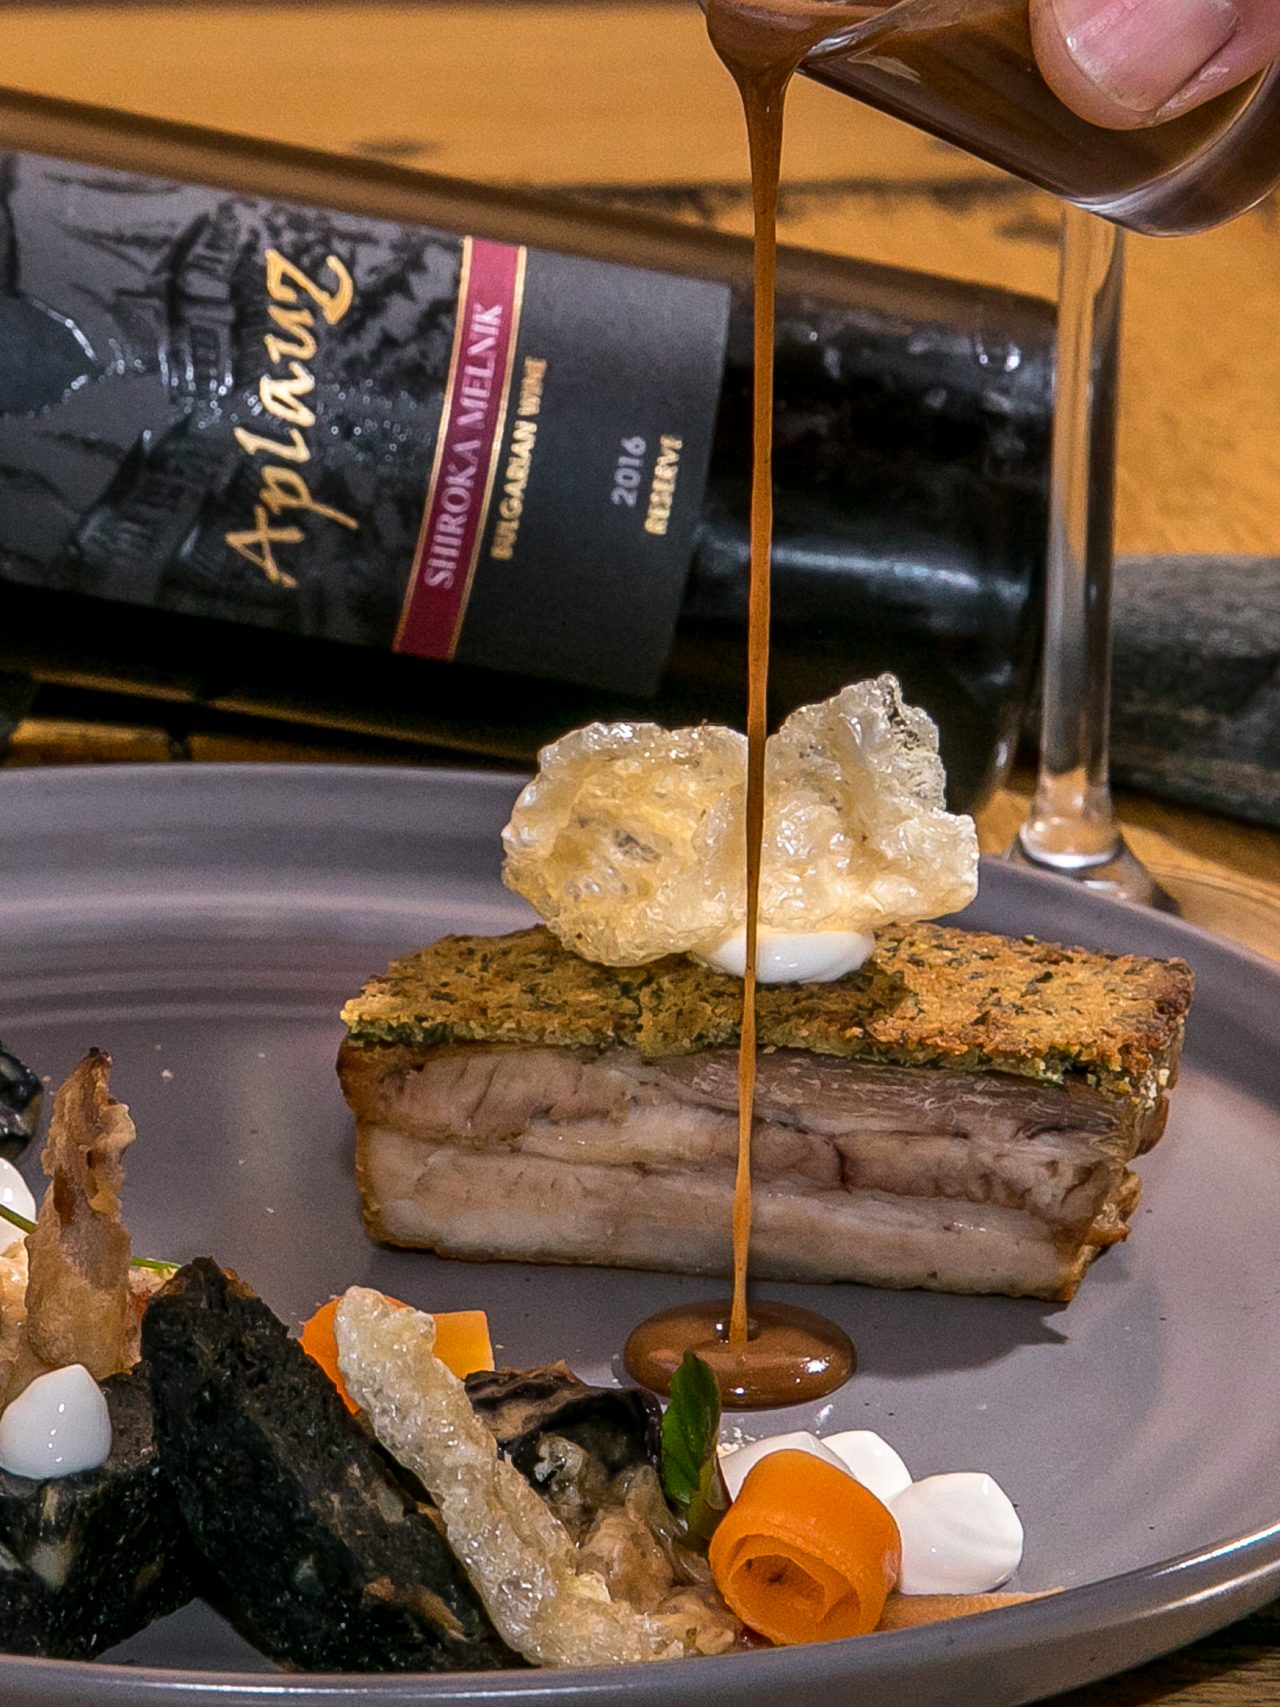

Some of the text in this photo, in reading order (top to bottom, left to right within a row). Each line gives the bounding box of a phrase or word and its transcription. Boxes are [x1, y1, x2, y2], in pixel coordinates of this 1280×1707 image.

[224, 249, 358, 588] Aplauz
[424, 302, 503, 590] SHIROKA MELNIK
[490, 355, 548, 560] BULGARIAN WINE
[610, 436, 647, 508] 2016
[644, 434, 683, 536] RESERVE
